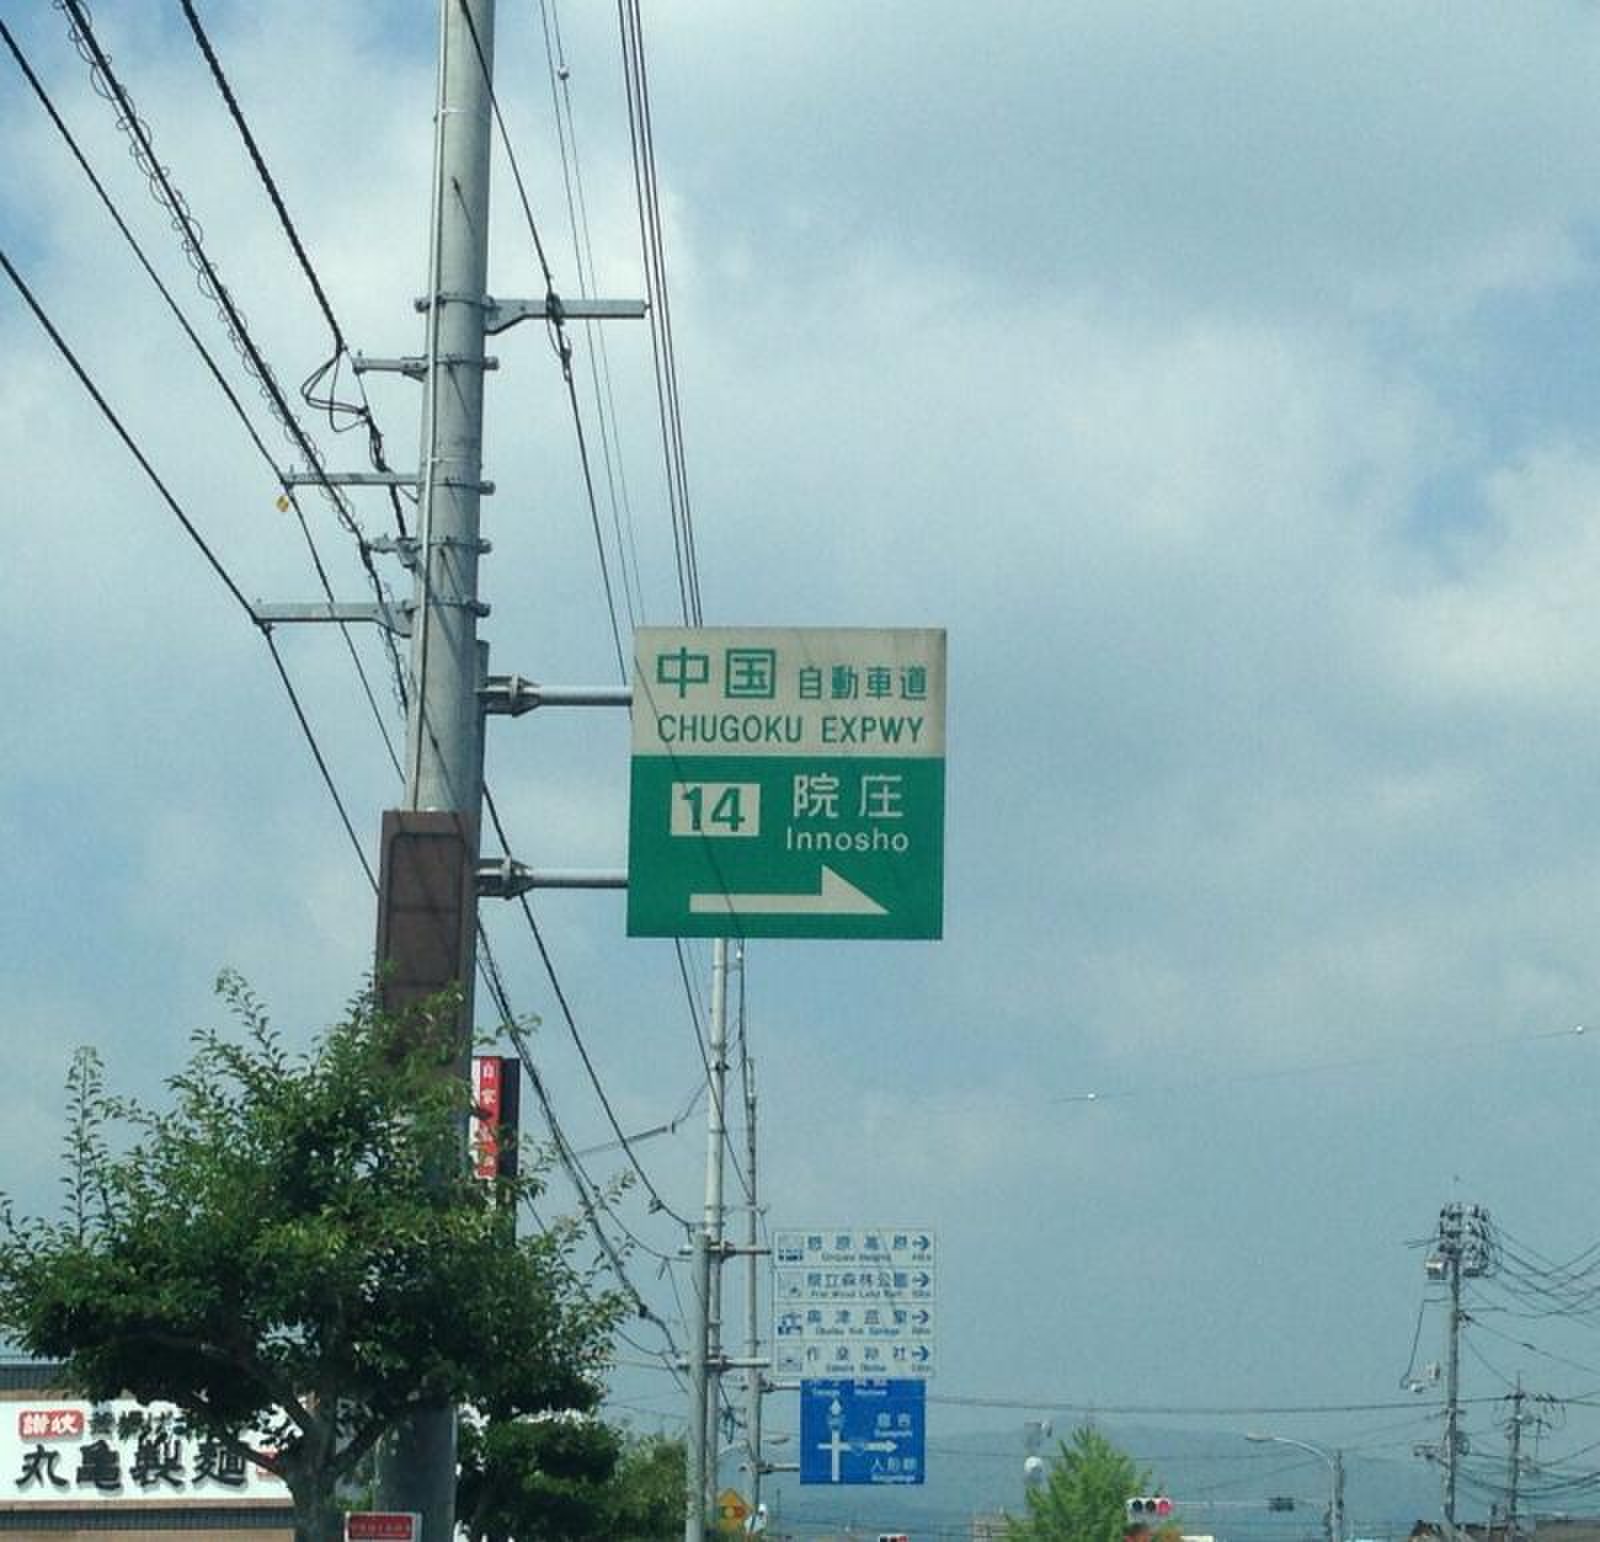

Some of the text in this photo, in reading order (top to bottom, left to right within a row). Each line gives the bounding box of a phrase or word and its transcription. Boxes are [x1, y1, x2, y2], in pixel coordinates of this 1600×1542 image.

[656, 646, 928, 701] 中国 自動車道
[657, 713, 924, 744] CHUGOKU EXPWY
[677, 785, 747, 832] 14
[785, 827, 910, 852] Innosho
